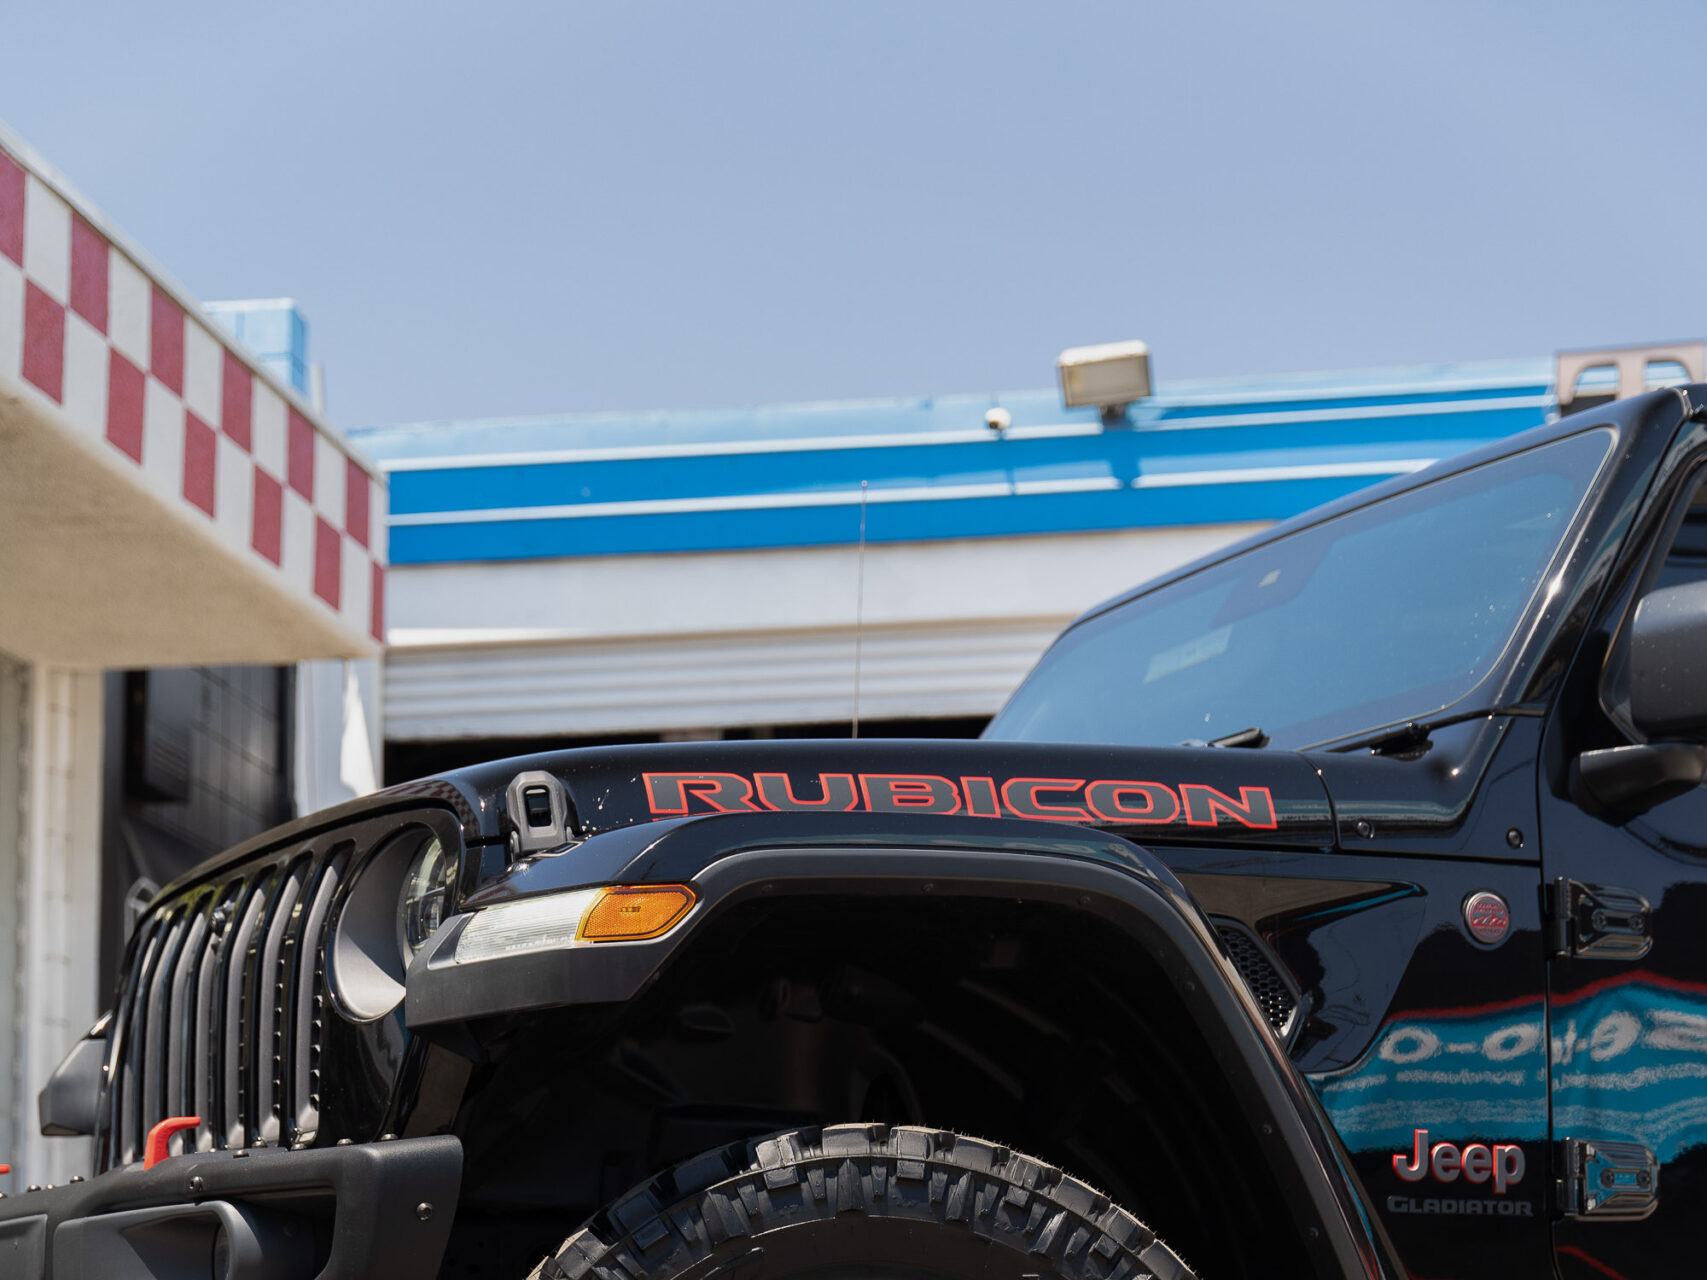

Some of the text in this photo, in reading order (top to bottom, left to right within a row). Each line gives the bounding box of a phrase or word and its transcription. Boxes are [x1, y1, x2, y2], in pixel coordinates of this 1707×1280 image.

[642, 773, 1279, 830] RUBICON
[1393, 1128, 1526, 1194] Jeep
[1386, 1195, 1534, 1217] GLADIATOR
